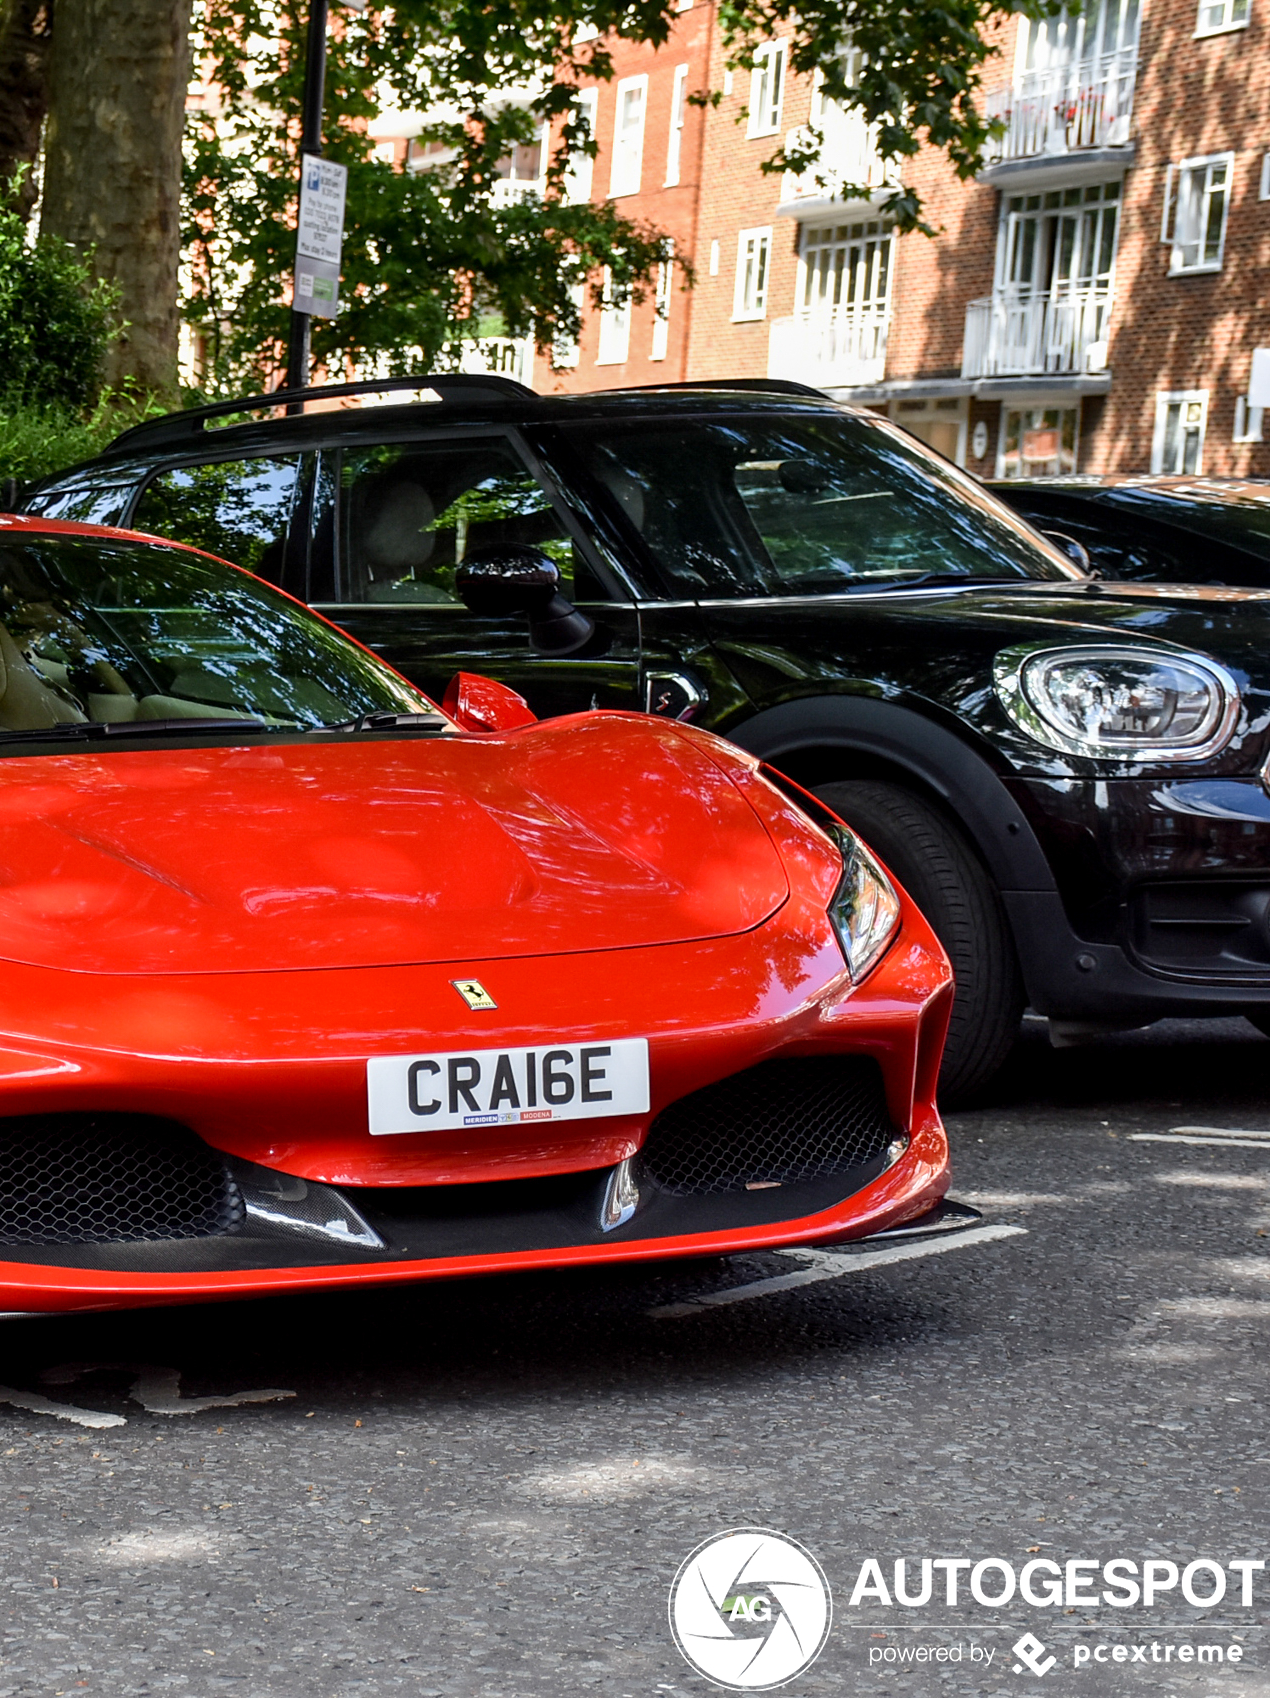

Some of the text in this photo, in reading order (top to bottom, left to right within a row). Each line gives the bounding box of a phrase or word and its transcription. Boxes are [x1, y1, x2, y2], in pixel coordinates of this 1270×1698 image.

[655, 692, 671, 711] S
[465, 1115, 498, 1124] MERIDIEN
[523, 1111, 550, 1119] MODENA
